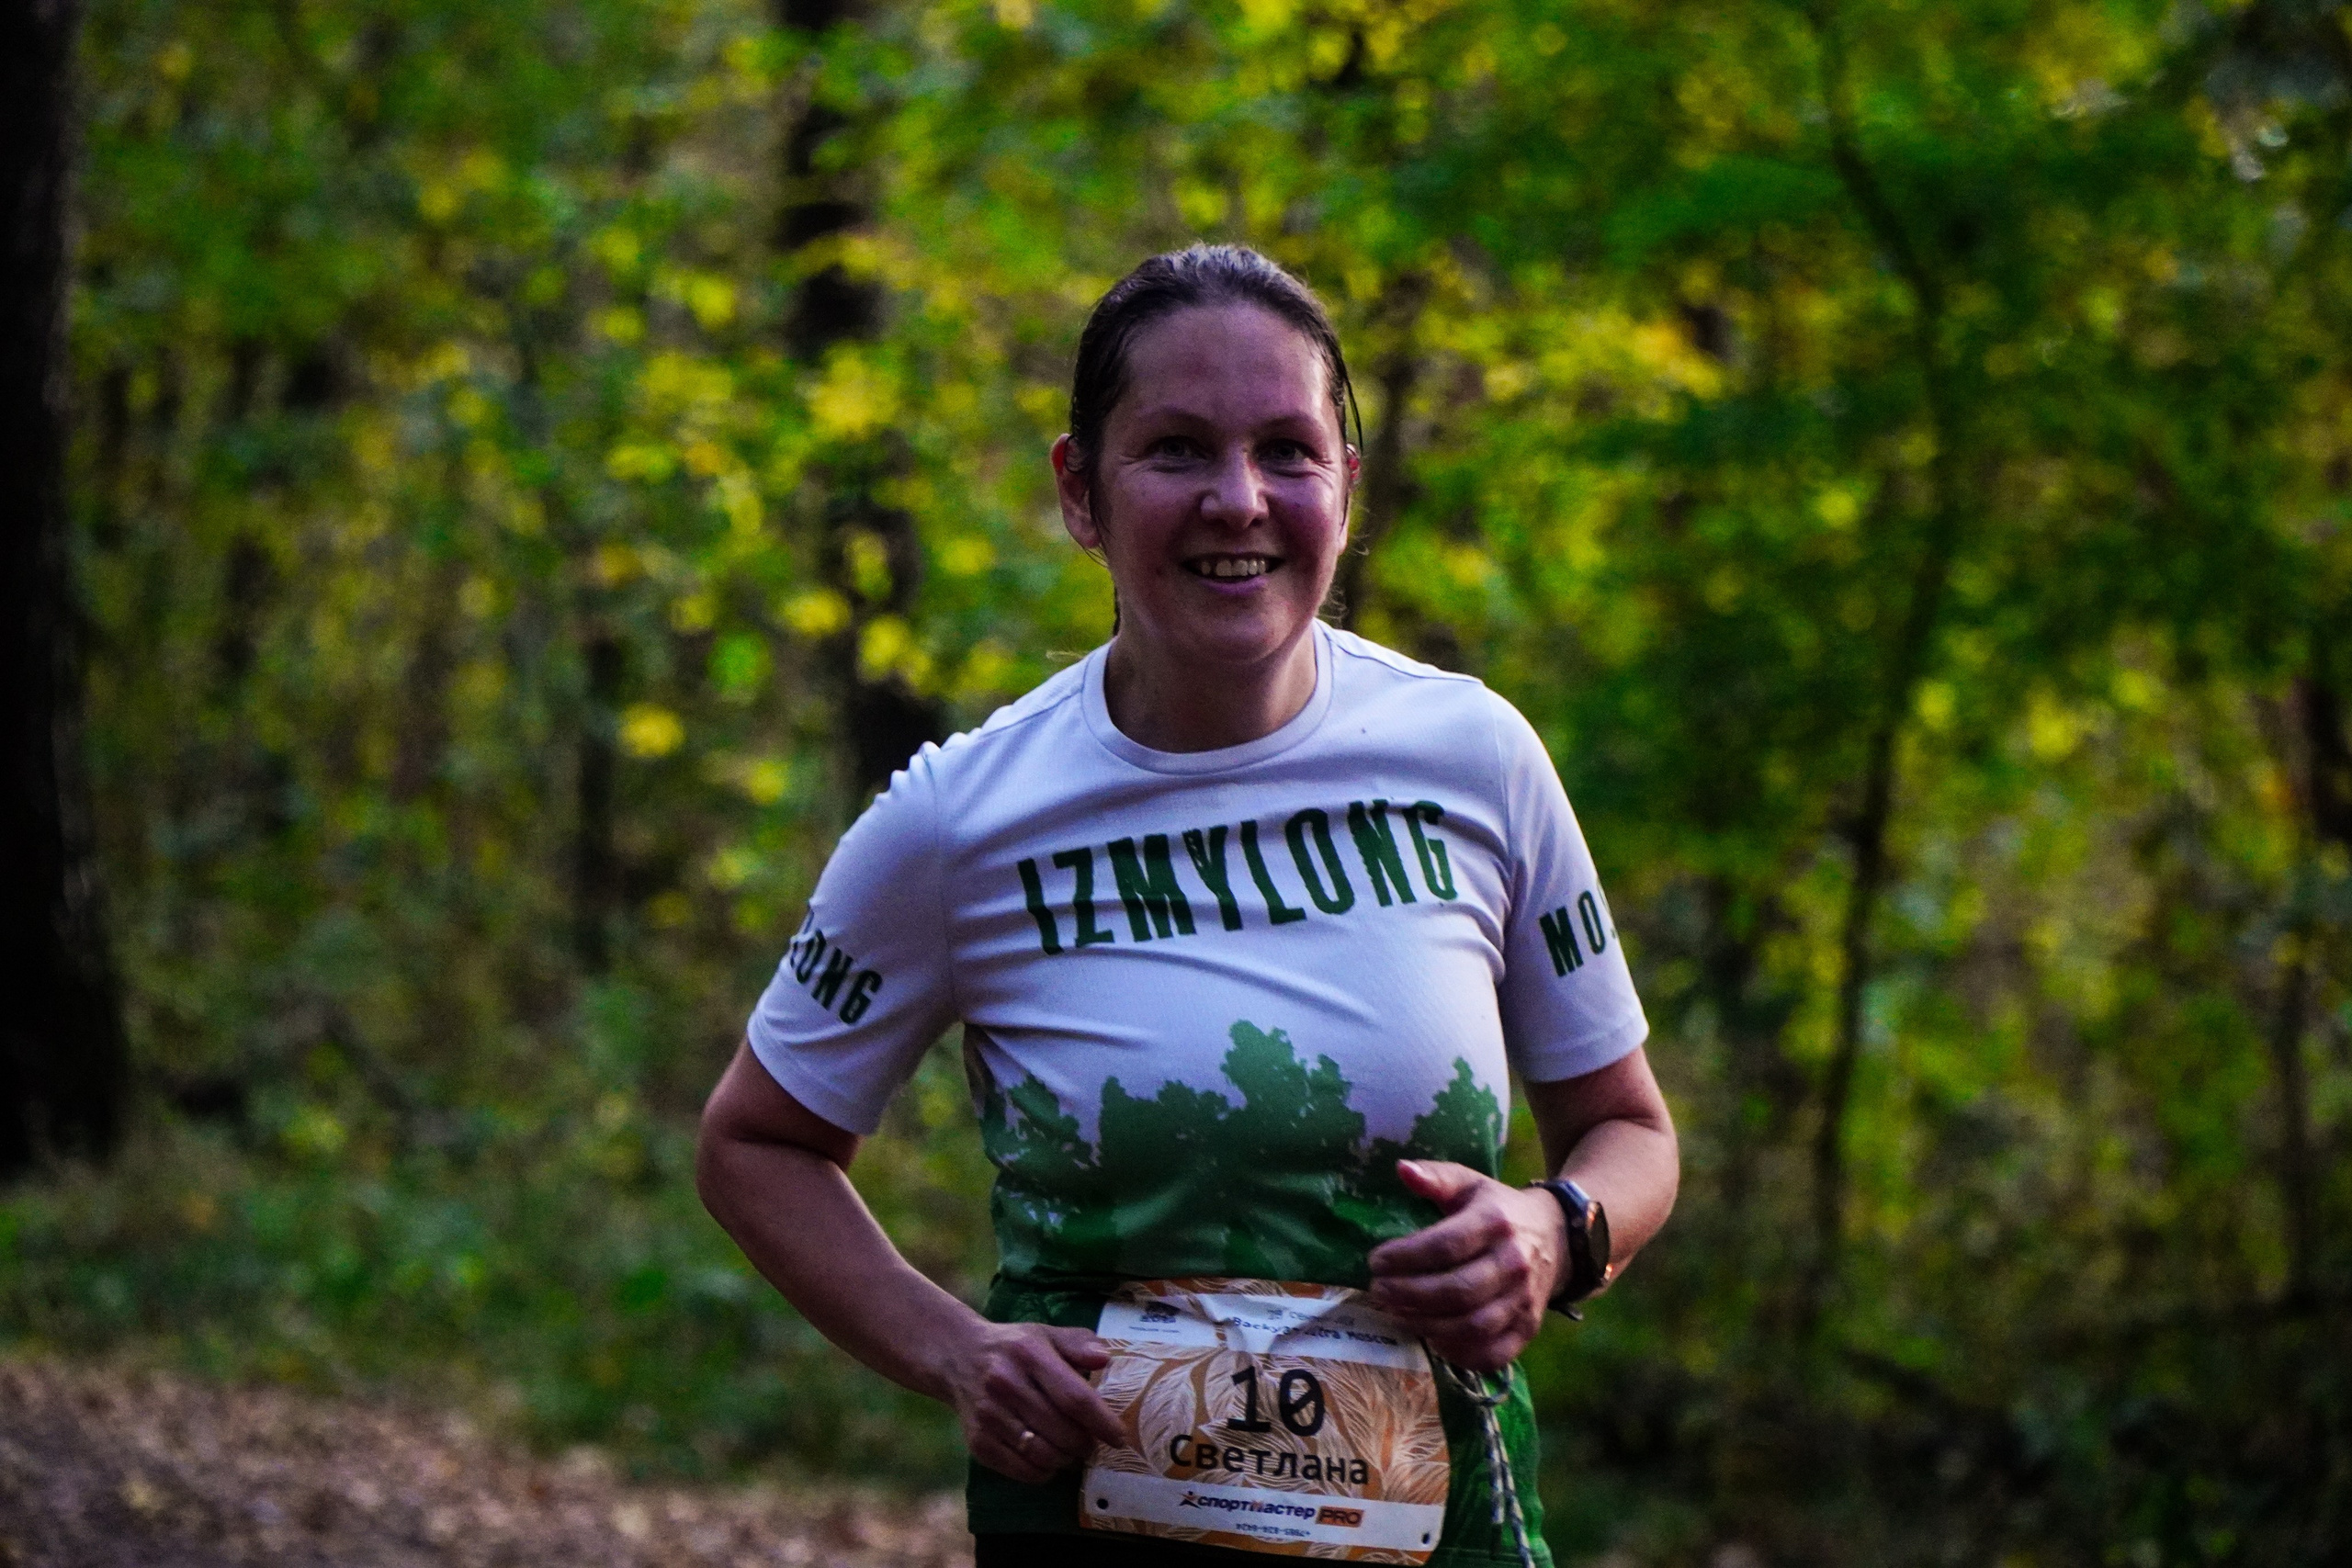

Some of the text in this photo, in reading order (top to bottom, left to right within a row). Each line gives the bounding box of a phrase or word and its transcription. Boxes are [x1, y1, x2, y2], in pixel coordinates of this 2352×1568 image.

[1017, 798, 1458, 955] IZMYLONG
[1540, 888, 1617, 977] MO
[1227, 1365, 1326, 1437] 10
[1170, 1434, 1369, 1485] Светлана
[1318, 1506, 1363, 1526] PRO
